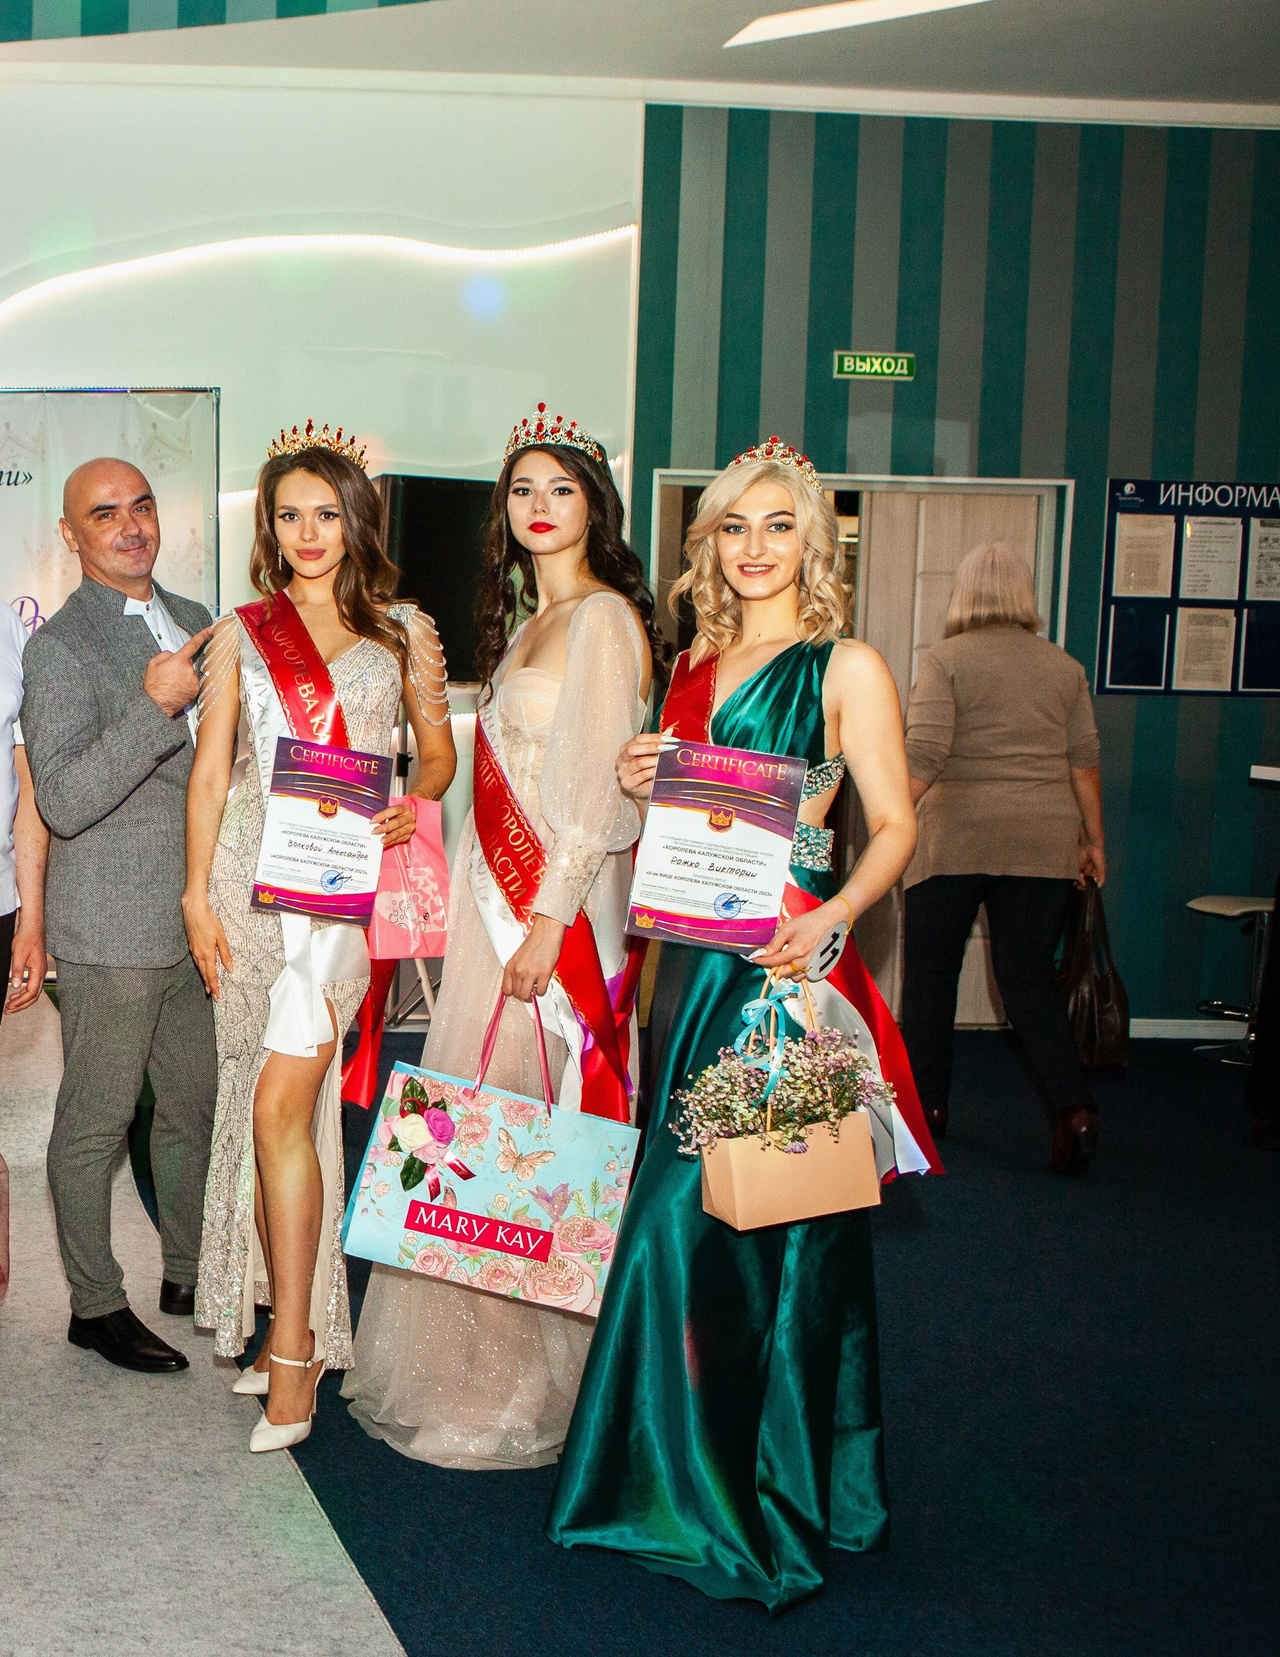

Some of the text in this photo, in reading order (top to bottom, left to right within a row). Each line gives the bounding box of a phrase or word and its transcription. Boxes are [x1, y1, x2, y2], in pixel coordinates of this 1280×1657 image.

[843, 356, 909, 375] ВЫХОД
[269, 622, 320, 715] КОРОЛЕВА
[290, 745, 379, 776] CERTIFICATE
[676, 748, 788, 781] CERTIFICATE
[499, 803, 547, 887] ОРОЛЕВ
[662, 844, 766, 867] «КОРОЛЕВА КАЛУЖСКОЙ ОБЛАСТИ»
[414, 1206, 544, 1255] MARY KAY
